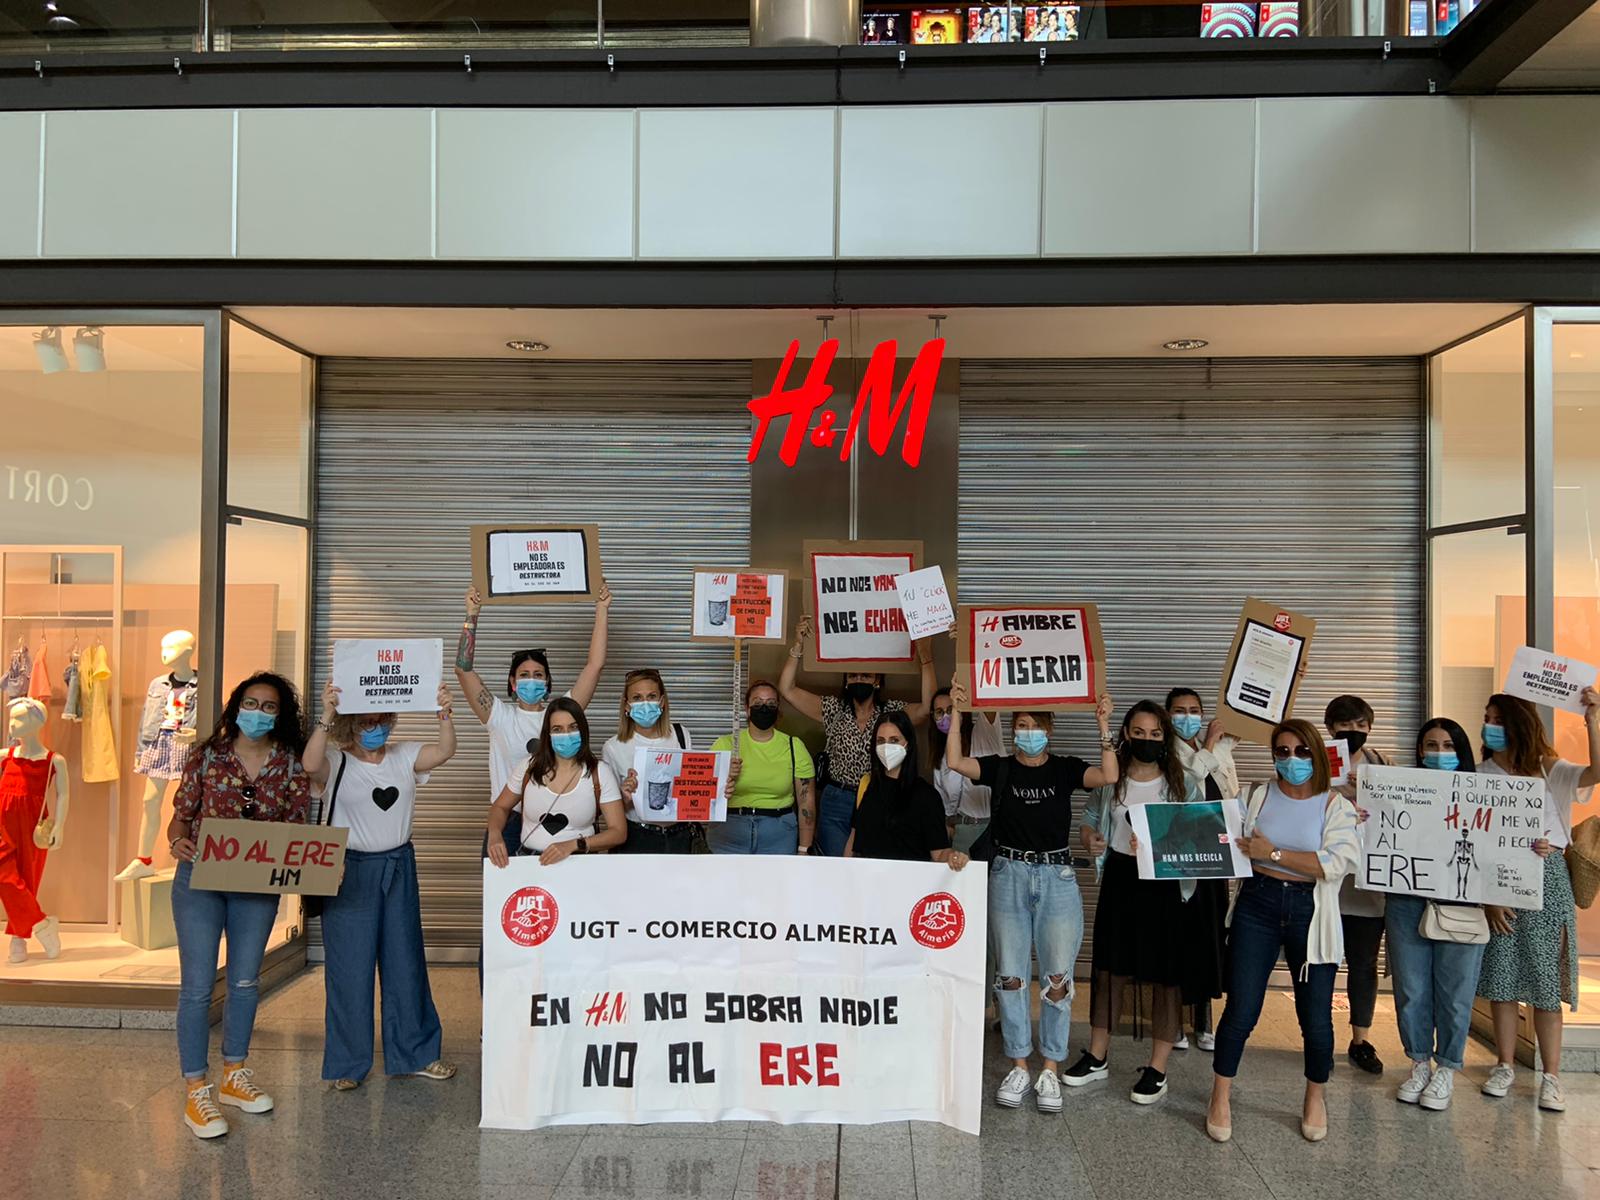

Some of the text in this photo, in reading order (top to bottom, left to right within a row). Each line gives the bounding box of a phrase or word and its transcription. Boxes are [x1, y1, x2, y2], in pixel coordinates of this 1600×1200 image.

[746, 338, 946, 468] H&M
[526, 541, 549, 552] H&M
[514, 562, 565, 570] EMPLEADORA ES
[822, 574, 900, 594] NO NOS VAM
[824, 611, 858, 634] NOS
[907, 610, 918, 620] ME
[981, 614, 1076, 632] HAMBRE
[378, 650, 404, 662] H&M
[379, 665, 400, 674] NO ES
[980, 655, 1082, 688] MISERIA
[1543, 660, 1568, 672] H&M
[360, 675, 420, 686] EMPLEADORA ES
[1522, 672, 1578, 692] EMPLEADORA ES
[1554, 672, 1563, 680] ES
[365, 688, 413, 696] DESTRUCTORA
[1526, 681, 1570, 696] DESTRUCTORA
[1012, 784, 1056, 799] WOMAN
[1486, 778, 1500, 790] ME
[1506, 781, 1535, 792] VOY
[1452, 791, 1543, 809] A QUEDAR XQ
[1380, 810, 1412, 830] NO
[1502, 816, 1520, 828] ME
[1525, 816, 1540, 828] VA
[1376, 832, 1404, 850] AL
[1498, 836, 1537, 848] A ECH
[202, 834, 340, 867] NO AL ERE
[1180, 854, 1193, 862] NOS
[1194, 853, 1224, 862] RECICLA
[270, 868, 301, 886] HM
[1366, 853, 1436, 892] ERE
[516, 896, 544, 912] UGT
[924, 900, 952, 916] UGT
[570, 920, 620, 940] UGT
[646, 920, 777, 940] COMERCIO
[785, 924, 898, 945] ALMERIA
[530, 993, 570, 1026] EN
[644, 992, 688, 1022] NO
[705, 992, 803, 1023] SOBRA
[820, 996, 898, 1026] NADIE
[583, 1042, 840, 1088] NO AL ERE
